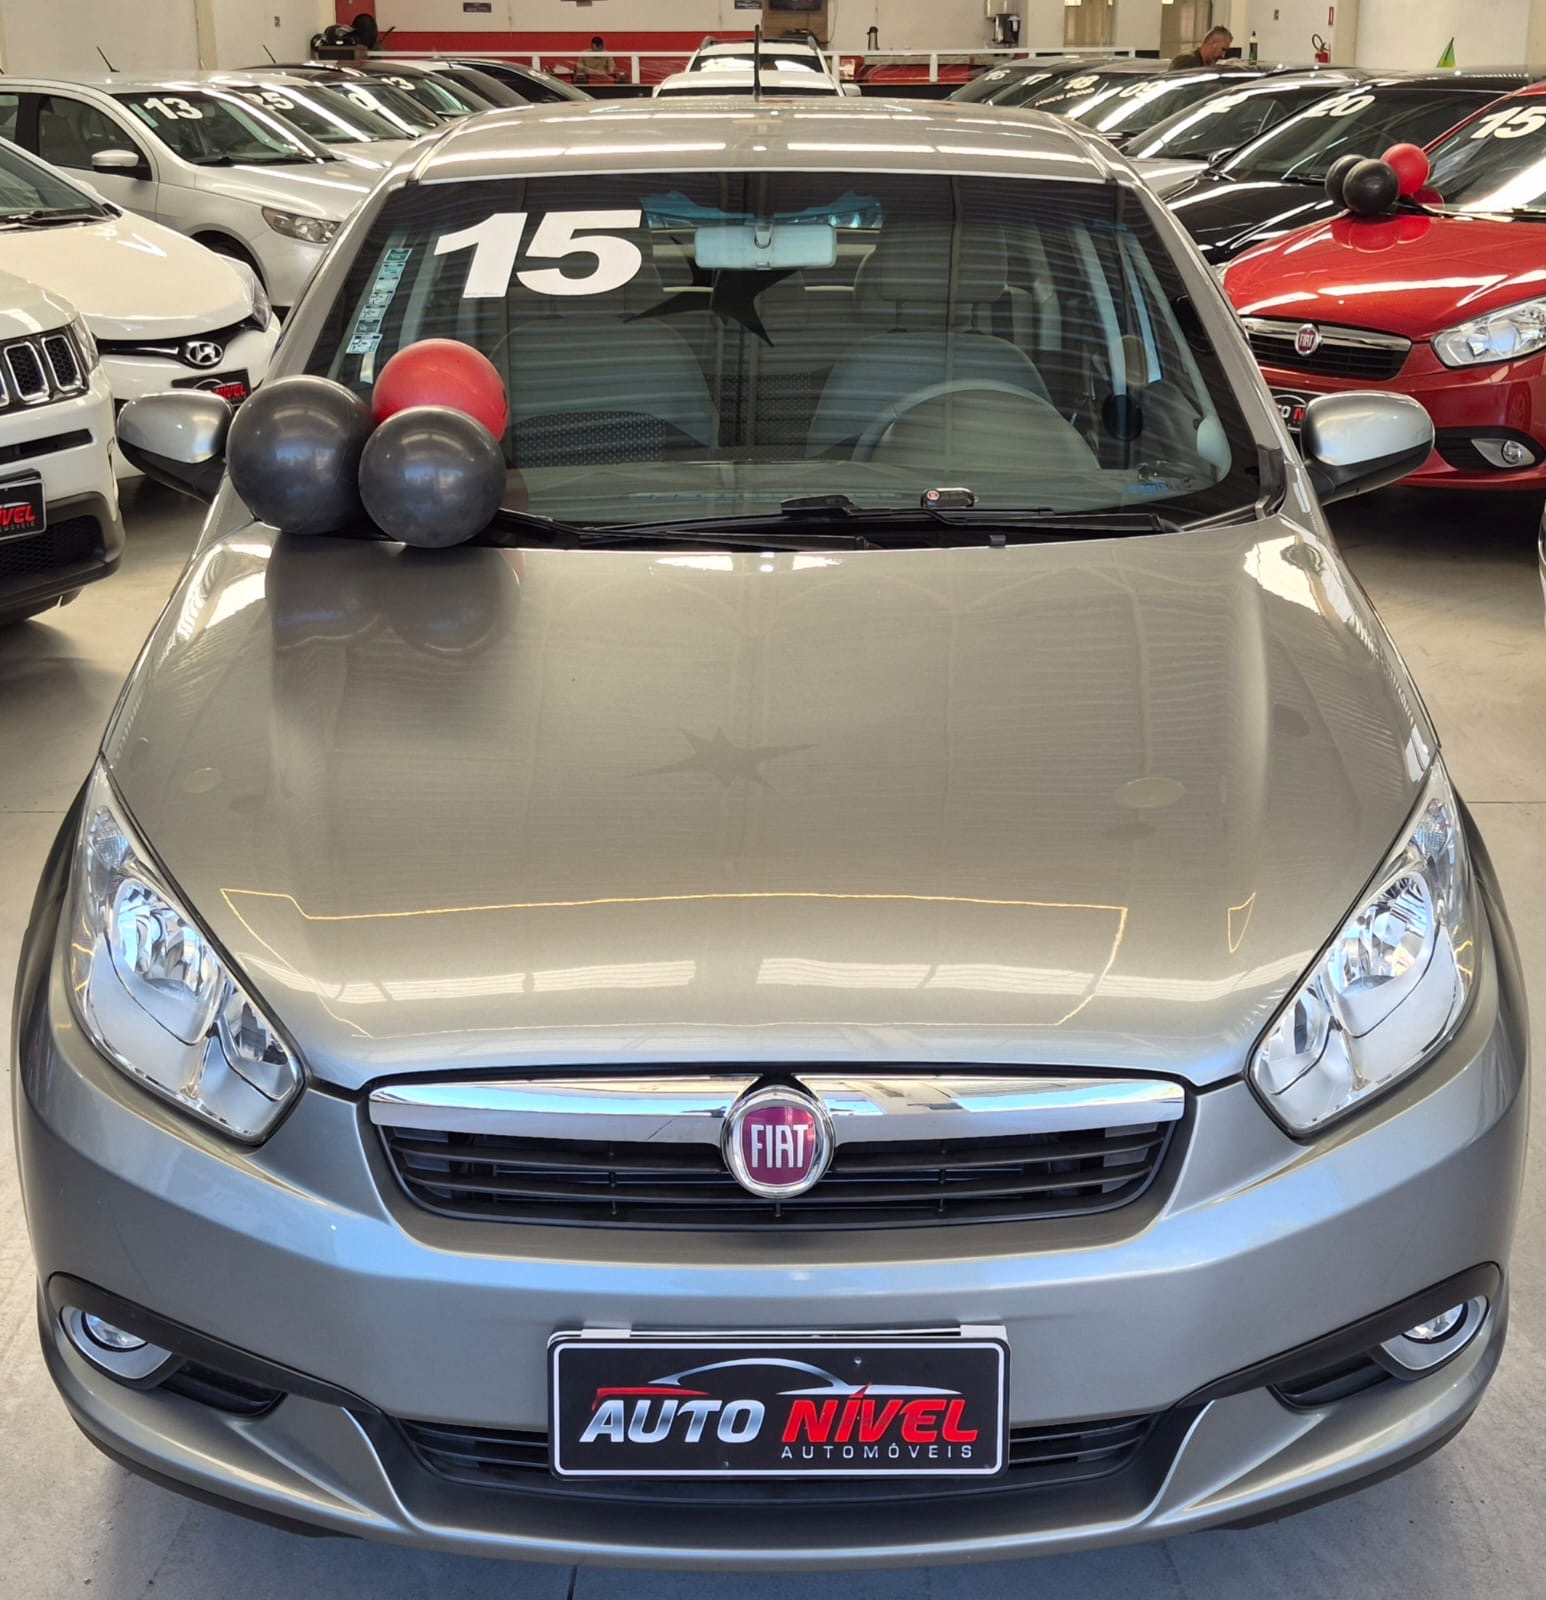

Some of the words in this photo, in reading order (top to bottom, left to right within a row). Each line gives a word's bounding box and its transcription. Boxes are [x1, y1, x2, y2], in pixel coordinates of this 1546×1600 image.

[143, 98, 203, 120] 13
[1471, 106, 1546, 139] 15
[434, 209, 643, 298] 15
[0, 505, 36, 526] VEL
[751, 1124, 809, 1168] FIAT
[579, 1399, 766, 1443] AUTO
[781, 1382, 978, 1443] NÍVEL
[781, 1442, 972, 1459] AUTOMÓVEIS
